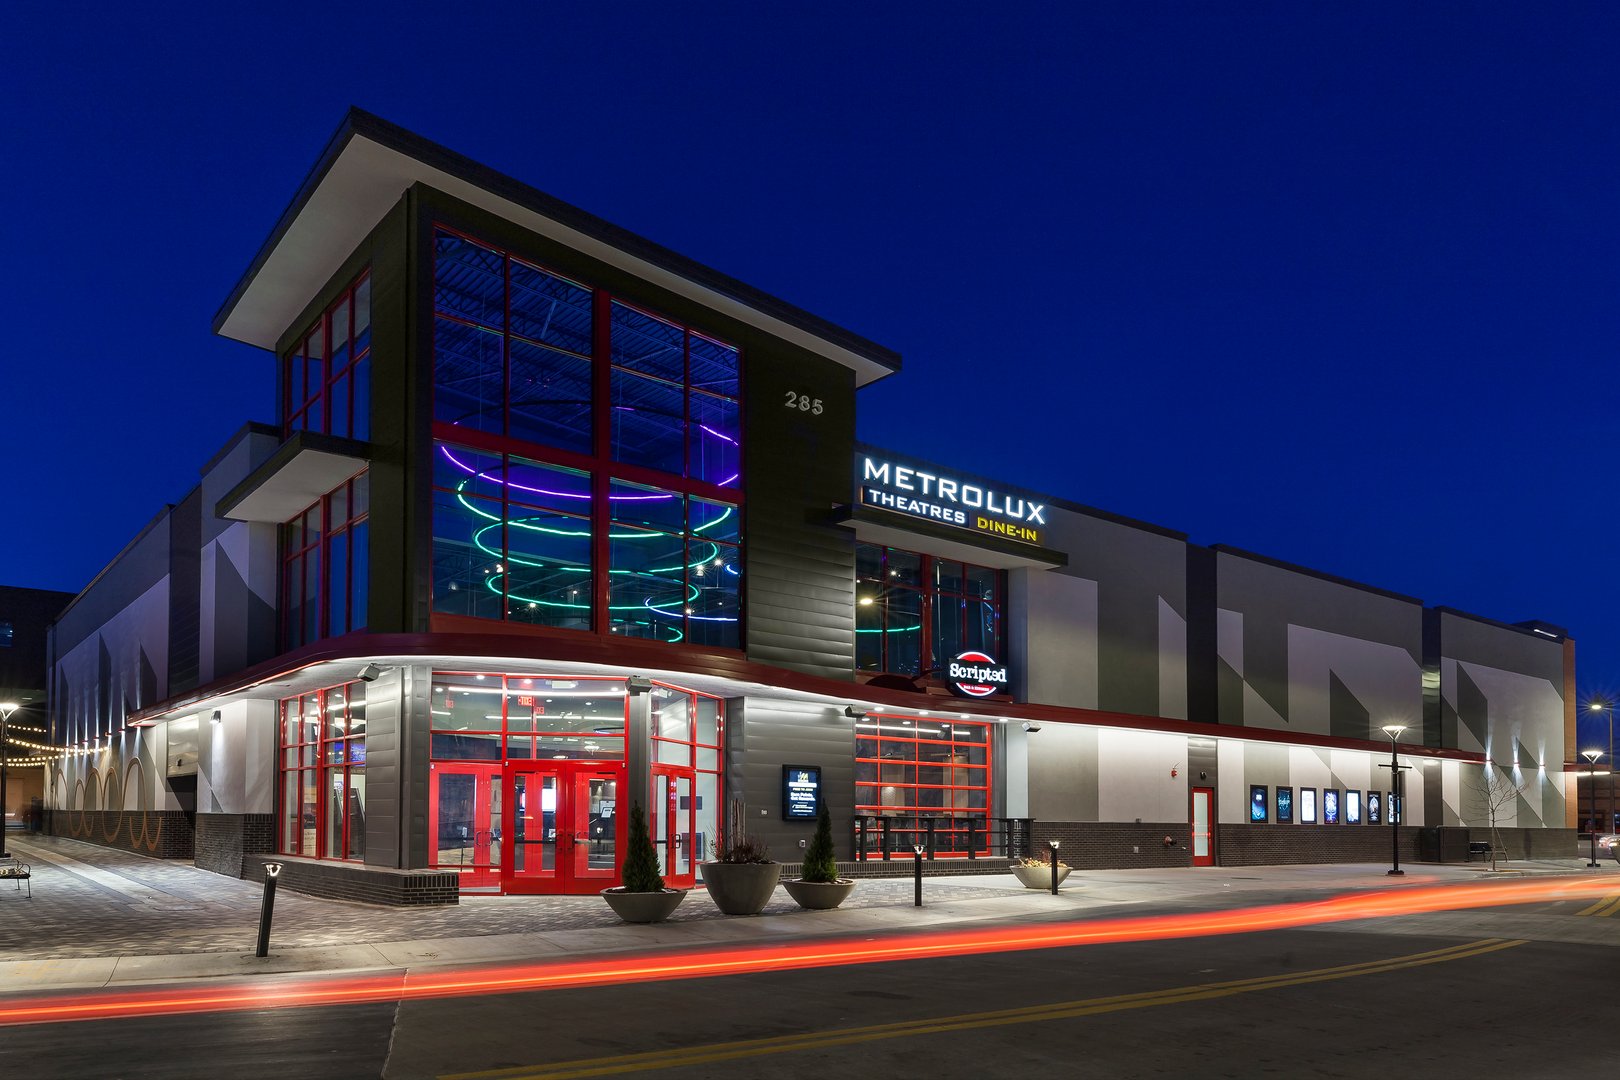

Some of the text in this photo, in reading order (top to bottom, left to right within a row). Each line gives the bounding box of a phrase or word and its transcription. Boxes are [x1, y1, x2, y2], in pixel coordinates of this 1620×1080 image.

[784, 391, 823, 416] 285
[864, 458, 1046, 524] METROLUX
[868, 489, 966, 524] THEATRES
[977, 516, 1038, 541] DINE-IN
[949, 663, 1007, 683] Scripted
